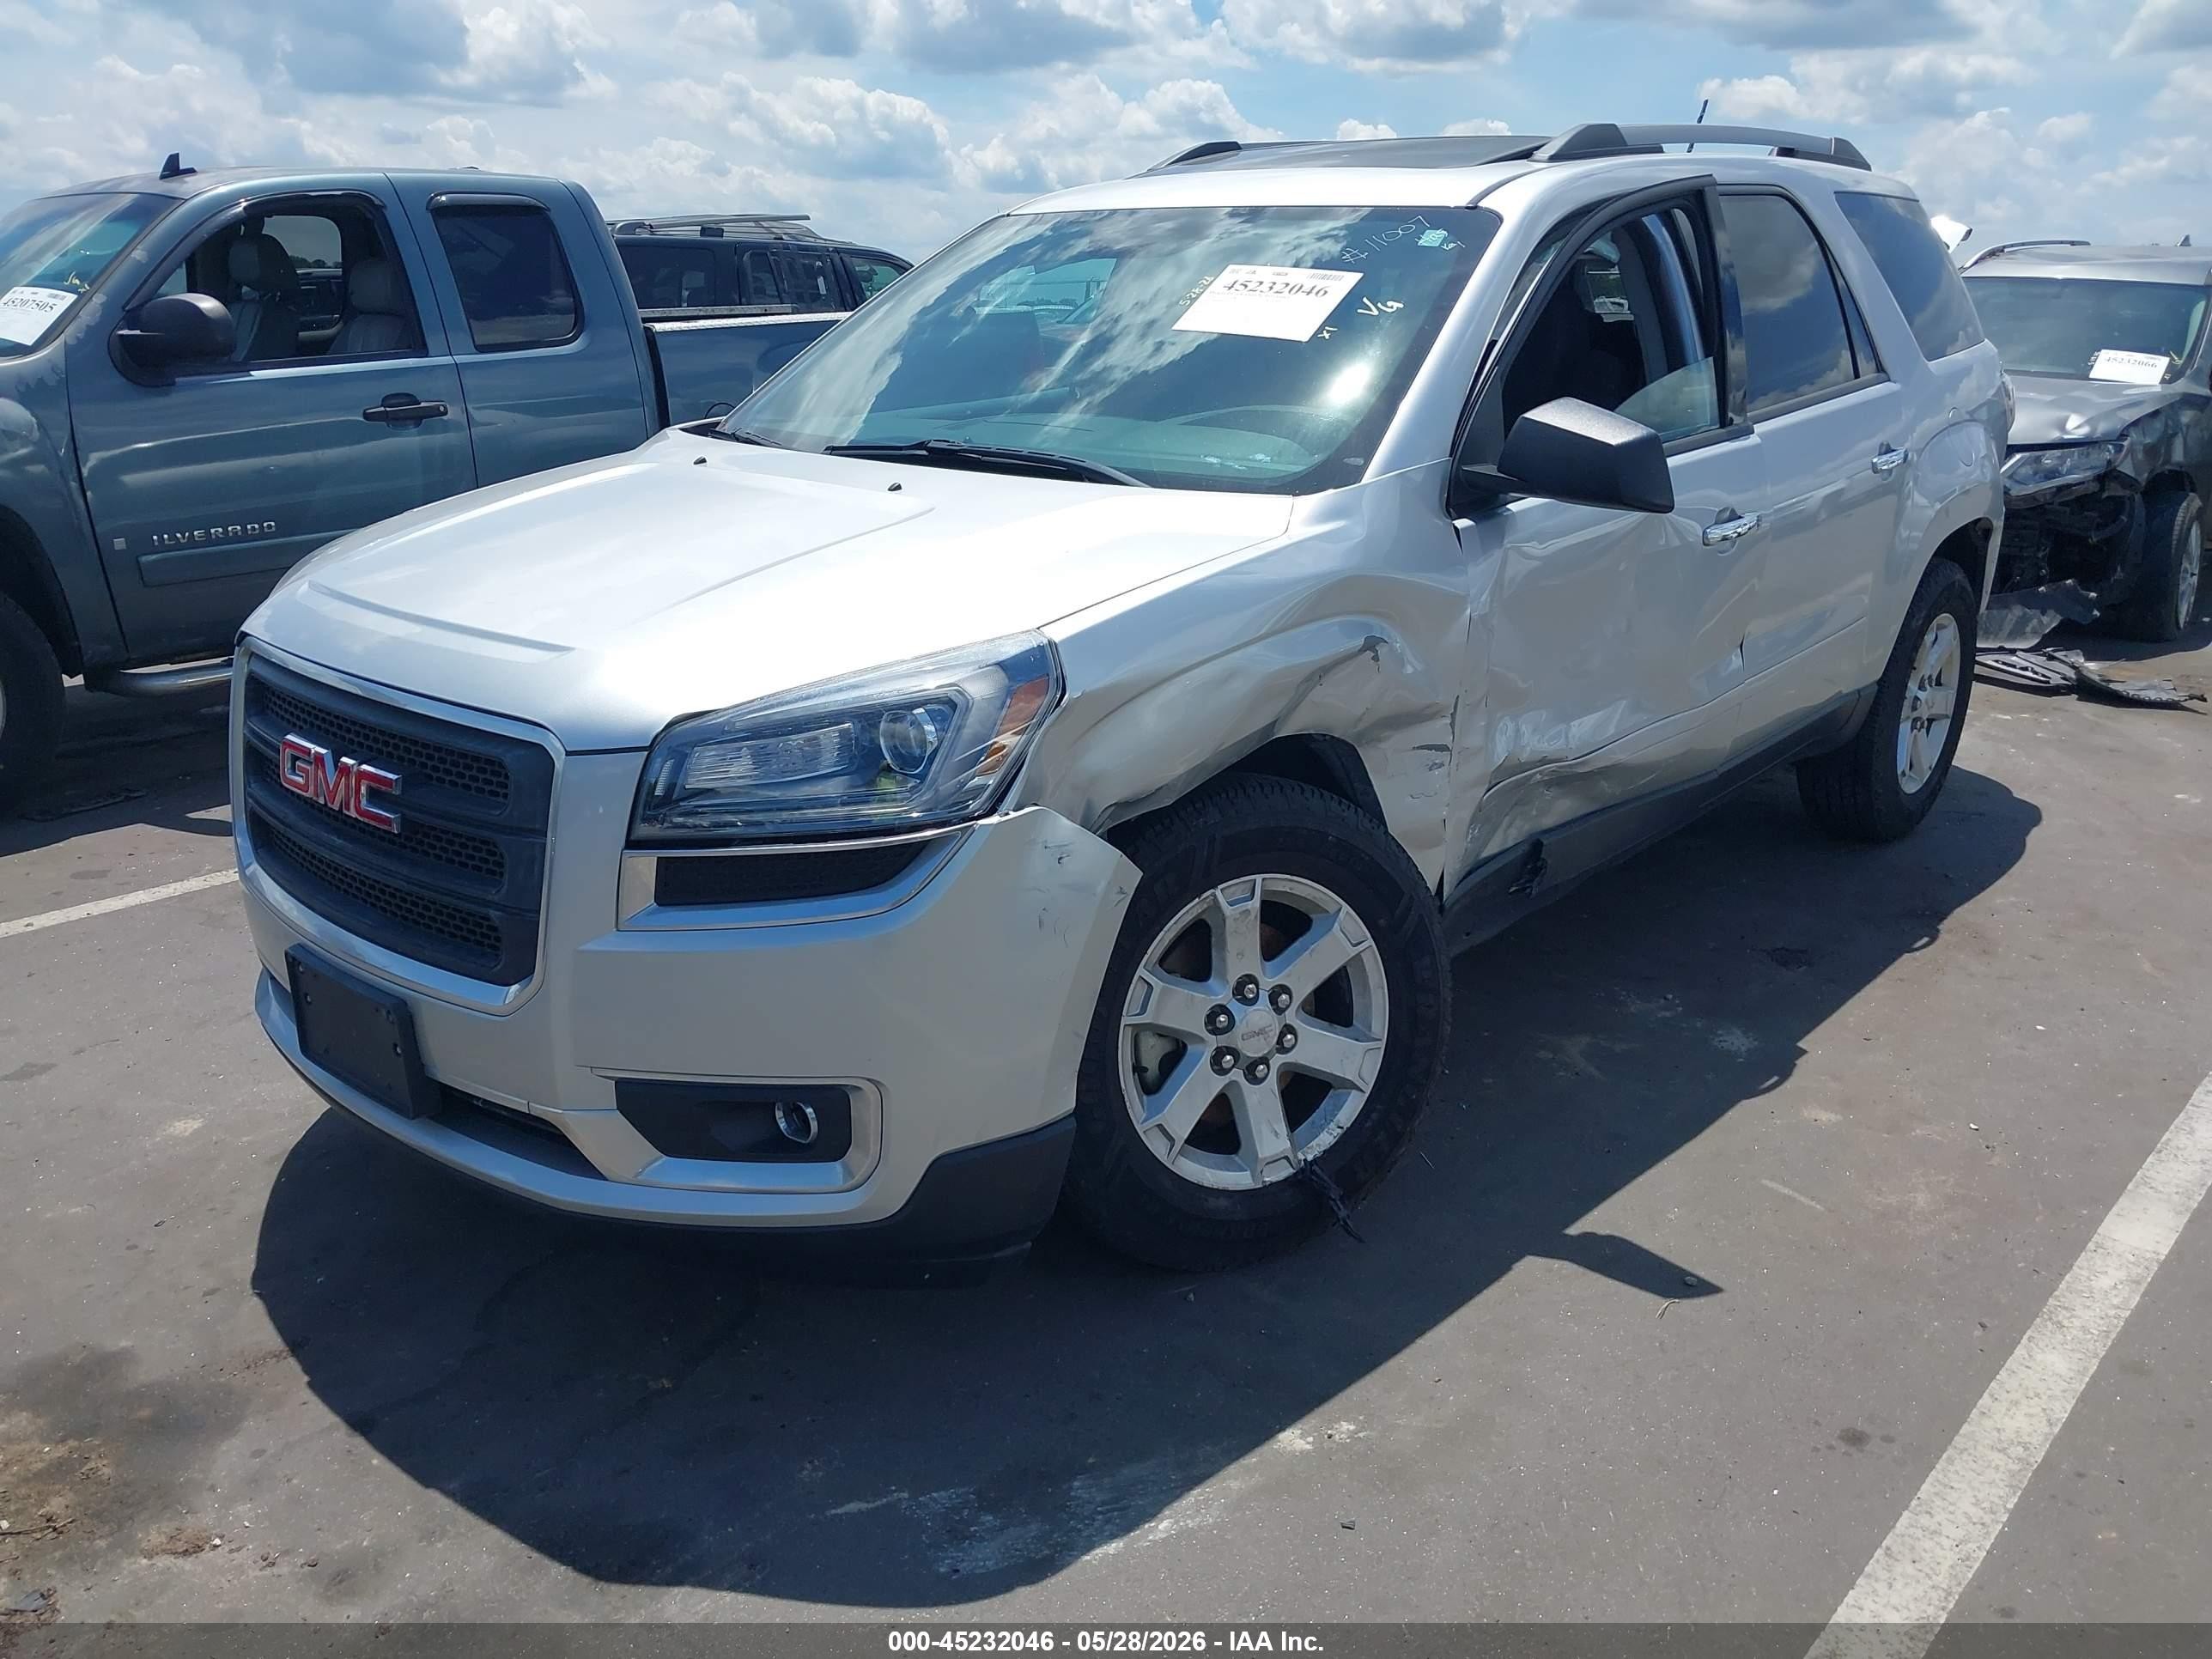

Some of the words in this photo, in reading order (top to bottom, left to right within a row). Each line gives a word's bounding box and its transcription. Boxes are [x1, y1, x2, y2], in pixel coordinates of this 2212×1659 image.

[1223, 279, 1332, 298] 45232046
[3, 297, 58, 313] 45207505
[280, 732, 402, 834] GMC
[1242, 1024, 1273, 1041] GMC
